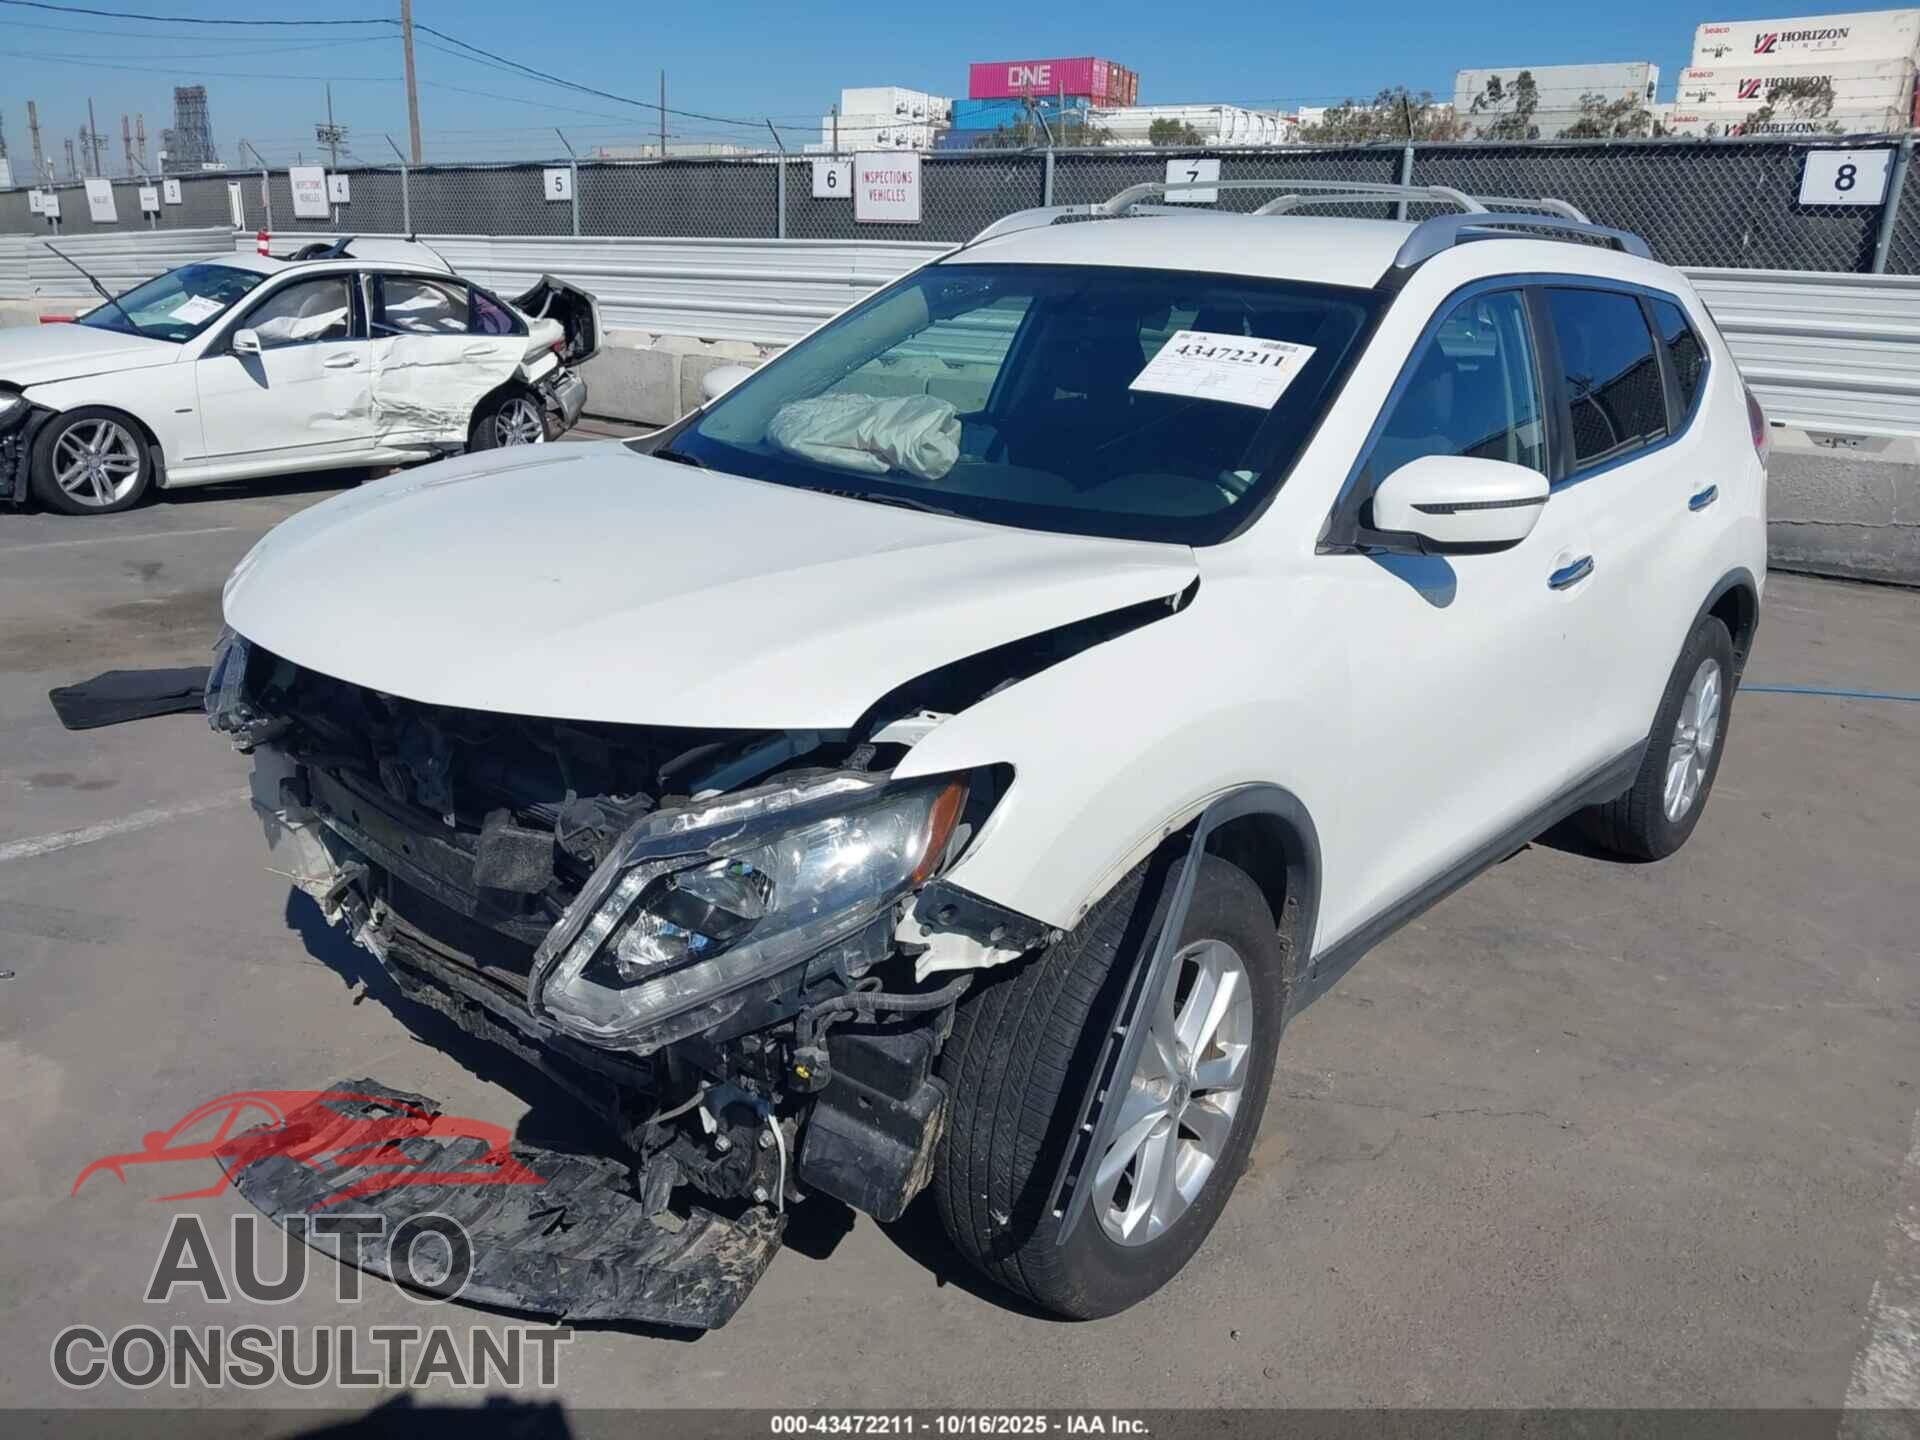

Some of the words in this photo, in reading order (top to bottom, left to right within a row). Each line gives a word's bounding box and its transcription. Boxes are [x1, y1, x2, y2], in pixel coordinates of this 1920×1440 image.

[1704, 26, 1730, 34] seaco
[1780, 28, 1850, 43] HORIZON
[1008, 64, 1051, 87] ONE
[1688, 71, 1714, 79] seaco
[1673, 115, 1699, 123] seaco
[1751, 122, 1817, 135] HORIZON
[827, 170, 837, 189] 6
[862, 171, 913, 184] INSPECTIONS
[1186, 171, 1199, 184] 7
[1834, 164, 1857, 191] 8
[336, 181, 343, 194] 4
[555, 176, 563, 193] 5
[868, 189, 906, 202] VEHICLES
[1175, 344, 1285, 367] 43472211
